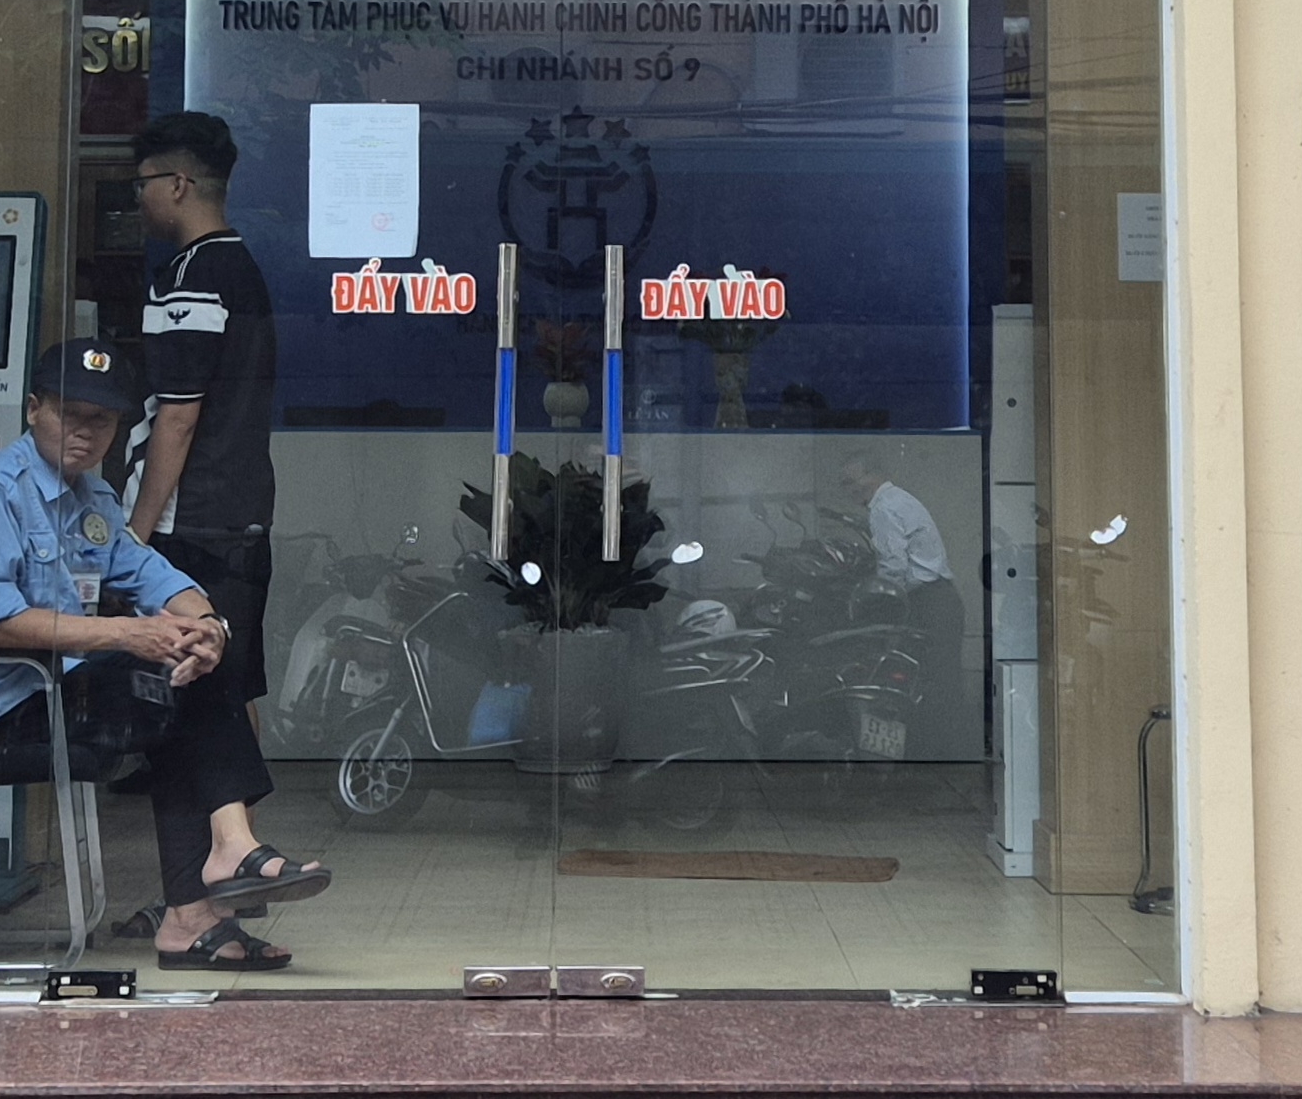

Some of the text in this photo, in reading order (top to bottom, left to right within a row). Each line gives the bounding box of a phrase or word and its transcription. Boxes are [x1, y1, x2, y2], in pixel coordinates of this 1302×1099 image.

[219, 0, 299, 31] TRUNG
[366, 1, 431, 40] PHỤC
[440, 2, 469, 40] VỤ
[456, 44, 701, 82] CHI NHÁNH SỐ 9
[332, 258, 476, 314] ĐẨY VÀO
[641, 264, 785, 319] ĐẨY VÀO
